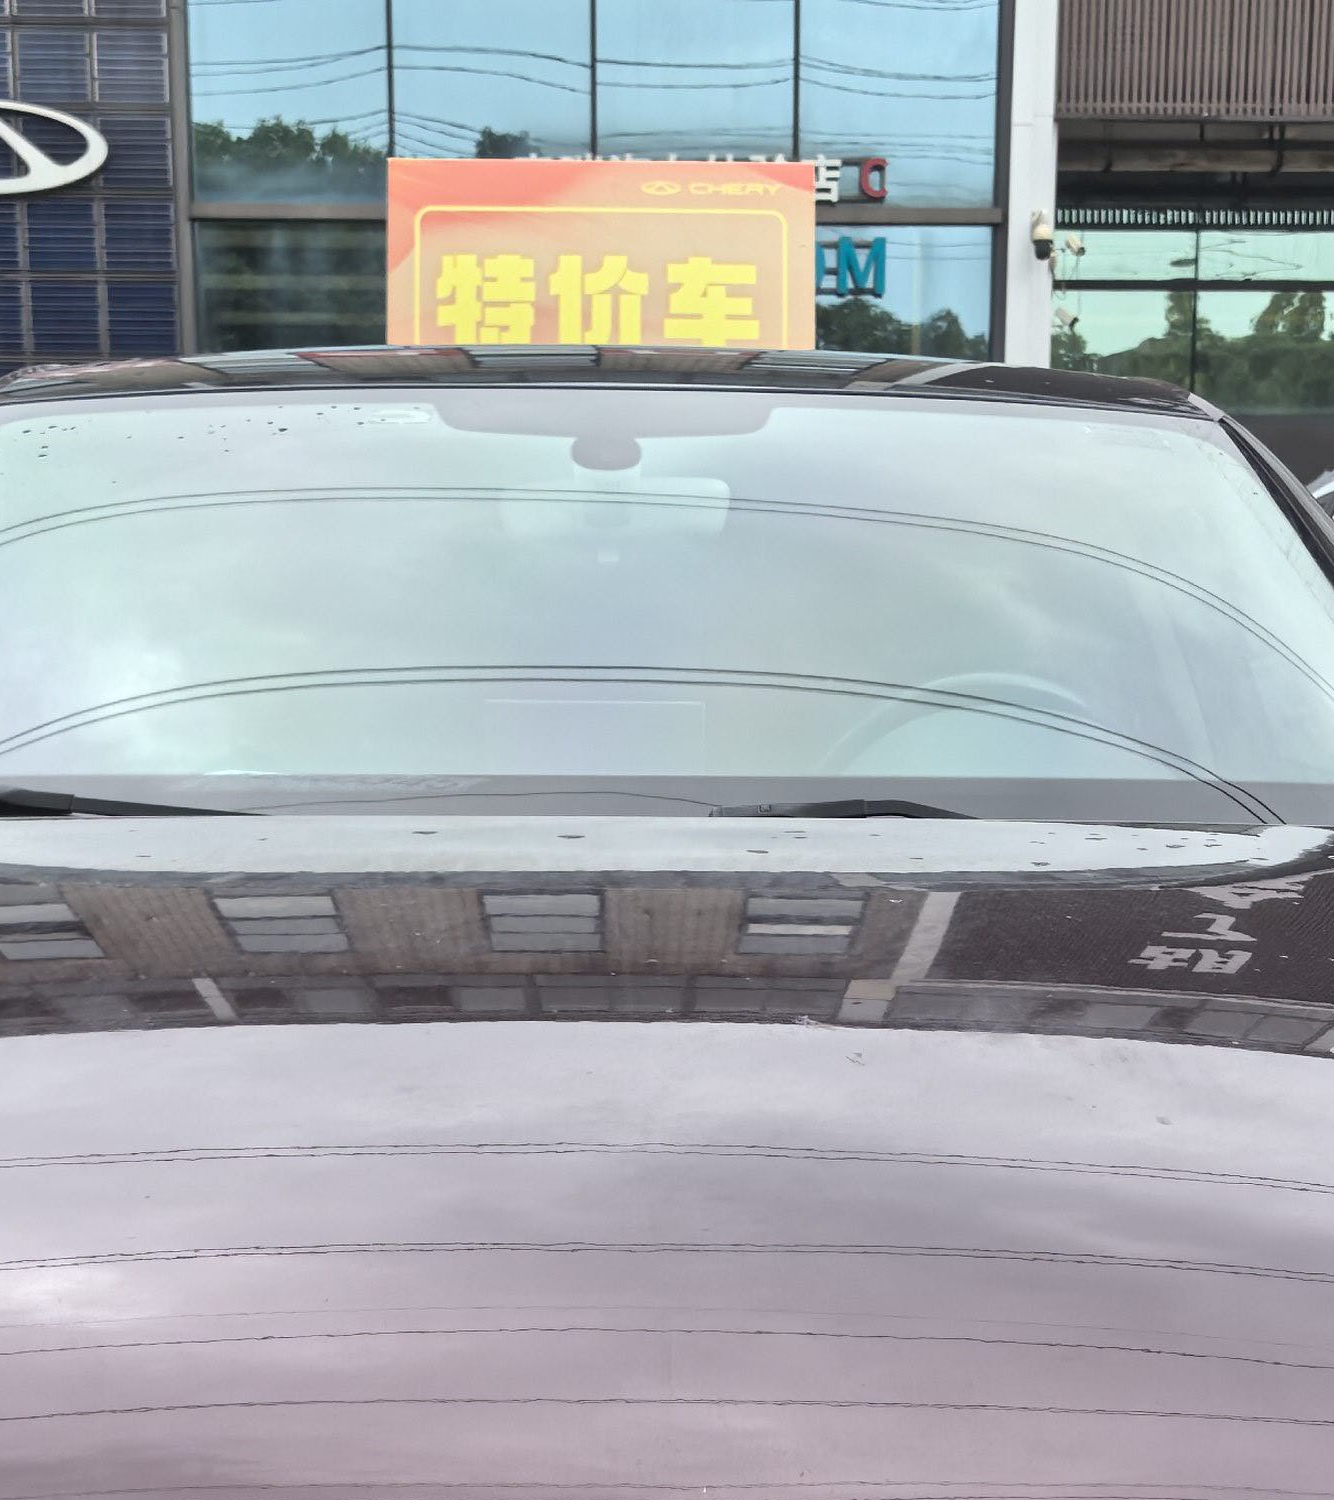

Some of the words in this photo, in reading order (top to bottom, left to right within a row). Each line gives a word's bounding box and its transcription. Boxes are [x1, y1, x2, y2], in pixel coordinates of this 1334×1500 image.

[687, 182, 783, 197] CHERY
[435, 253, 761, 347] 特价车
